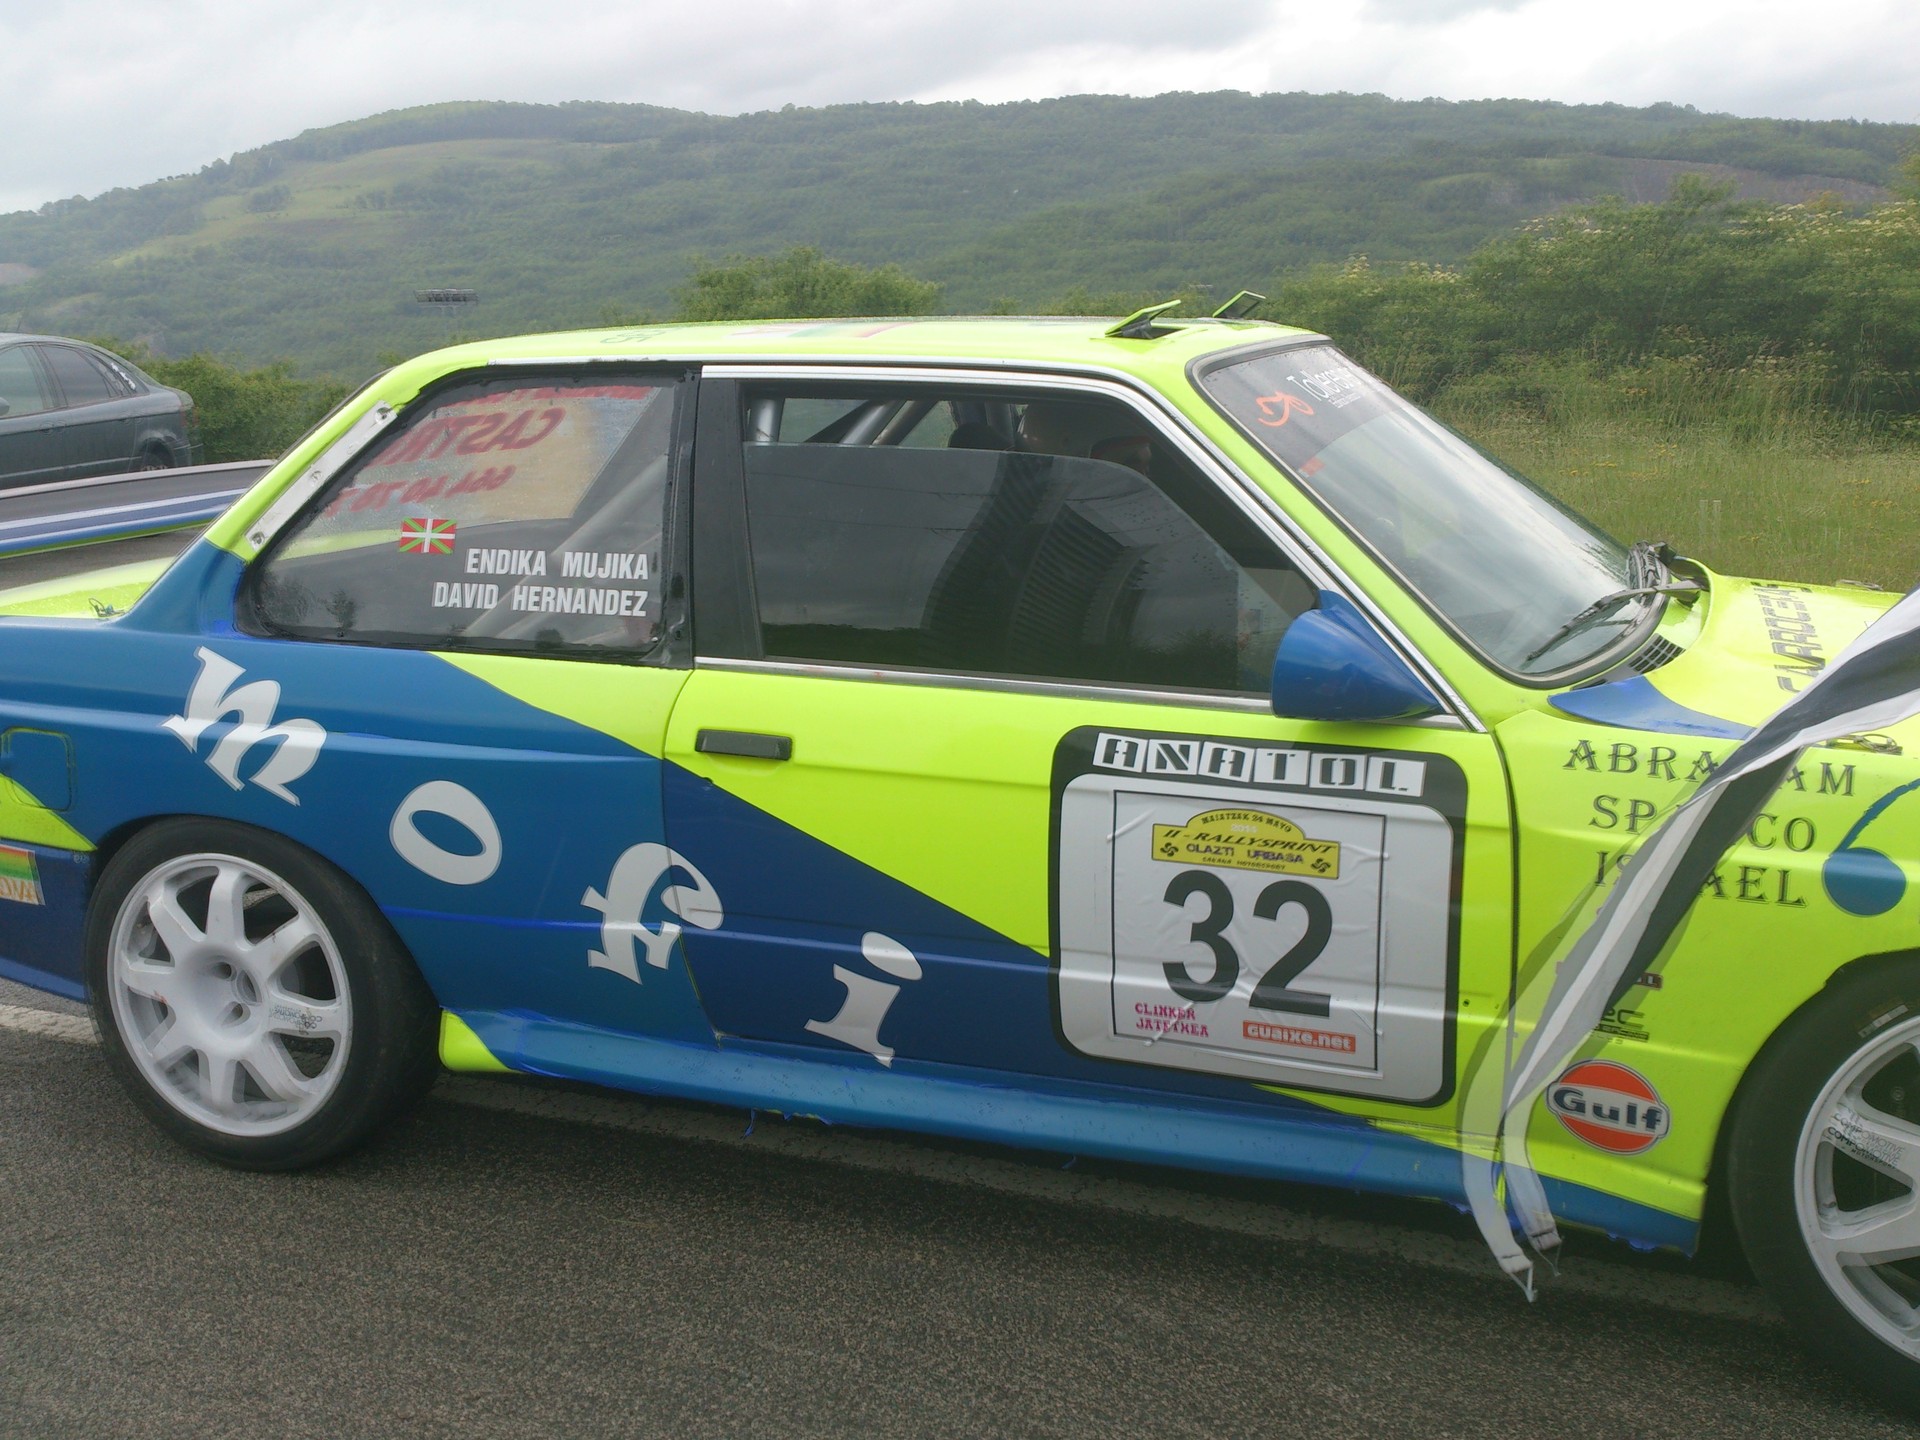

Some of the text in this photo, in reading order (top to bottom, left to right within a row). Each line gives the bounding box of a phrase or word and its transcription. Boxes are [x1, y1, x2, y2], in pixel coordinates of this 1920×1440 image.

[465, 548, 649, 580] ENDIKA MUJIKA
[432, 582, 649, 617] DAVID HERNANDEZ
[1100, 735, 1412, 794] ANATOL
[1563, 739, 1855, 797] ABRAAM
[1163, 829, 1181, 839] II
[1193, 832, 1337, 854] RALLYSPRINT
[1266, 817, 1292, 833] MAYO
[1588, 794, 1816, 852] SPCO
[1186, 843, 1305, 864] OLAZTI URBASA
[1162, 870, 1333, 1018] 32
[1553, 1087, 1662, 1132] Gulf
